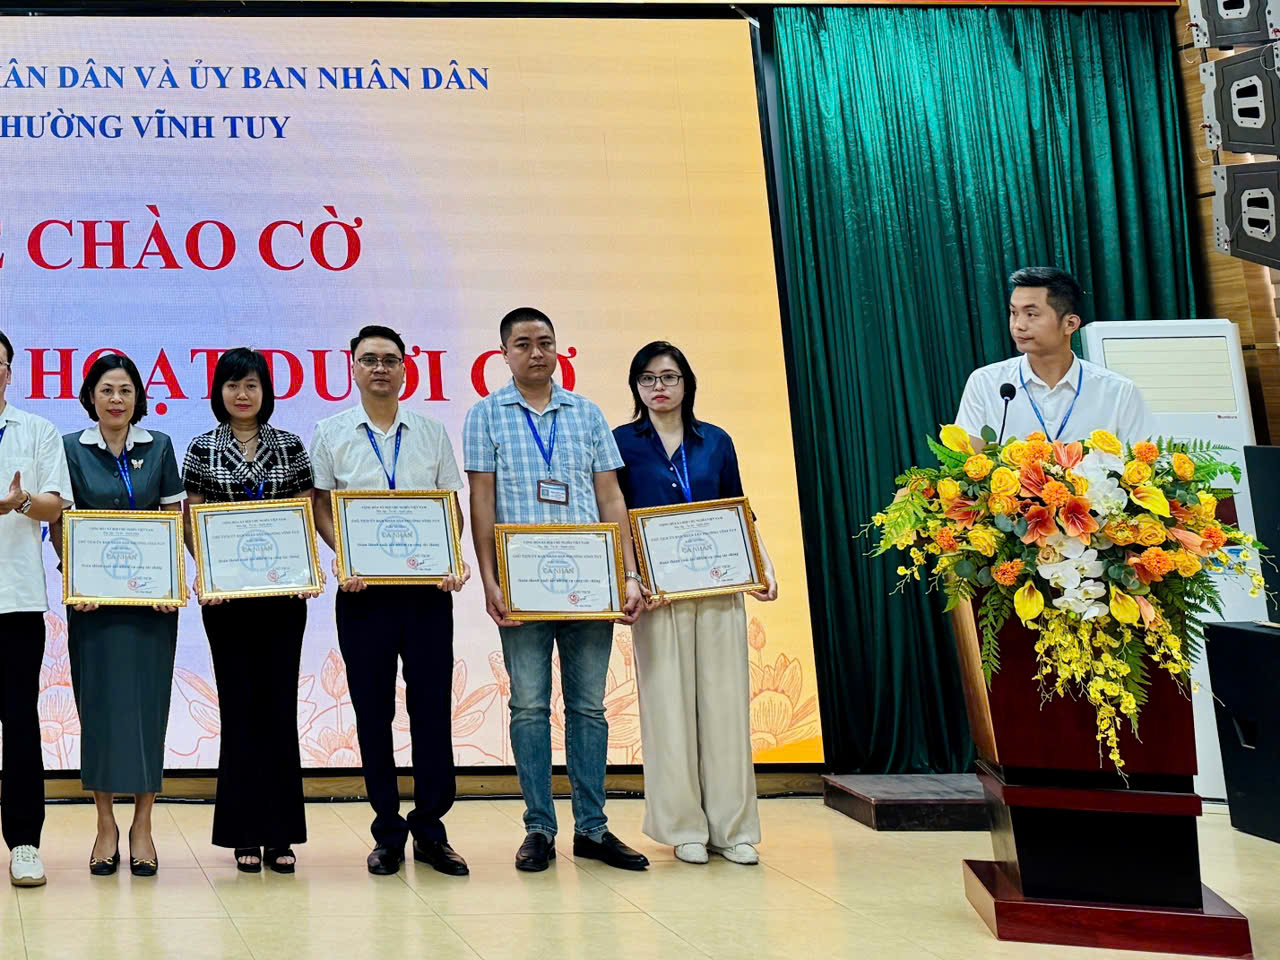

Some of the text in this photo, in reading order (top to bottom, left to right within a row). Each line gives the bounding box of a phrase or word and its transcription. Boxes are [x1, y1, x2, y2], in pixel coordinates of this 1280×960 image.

[57, 59, 125, 89] DÂN
[134, 59, 180, 89] VÀ
[189, 59, 232, 89] ỦY
[241, 66, 308, 89] BAN
[318, 59, 411, 90] NHÂN
[420, 60, 490, 90] DÂN
[131, 109, 215, 139] VĨNH
[222, 115, 291, 139] TUY
[26, 205, 237, 272] CHÀO
[258, 205, 364, 272] CỜ
